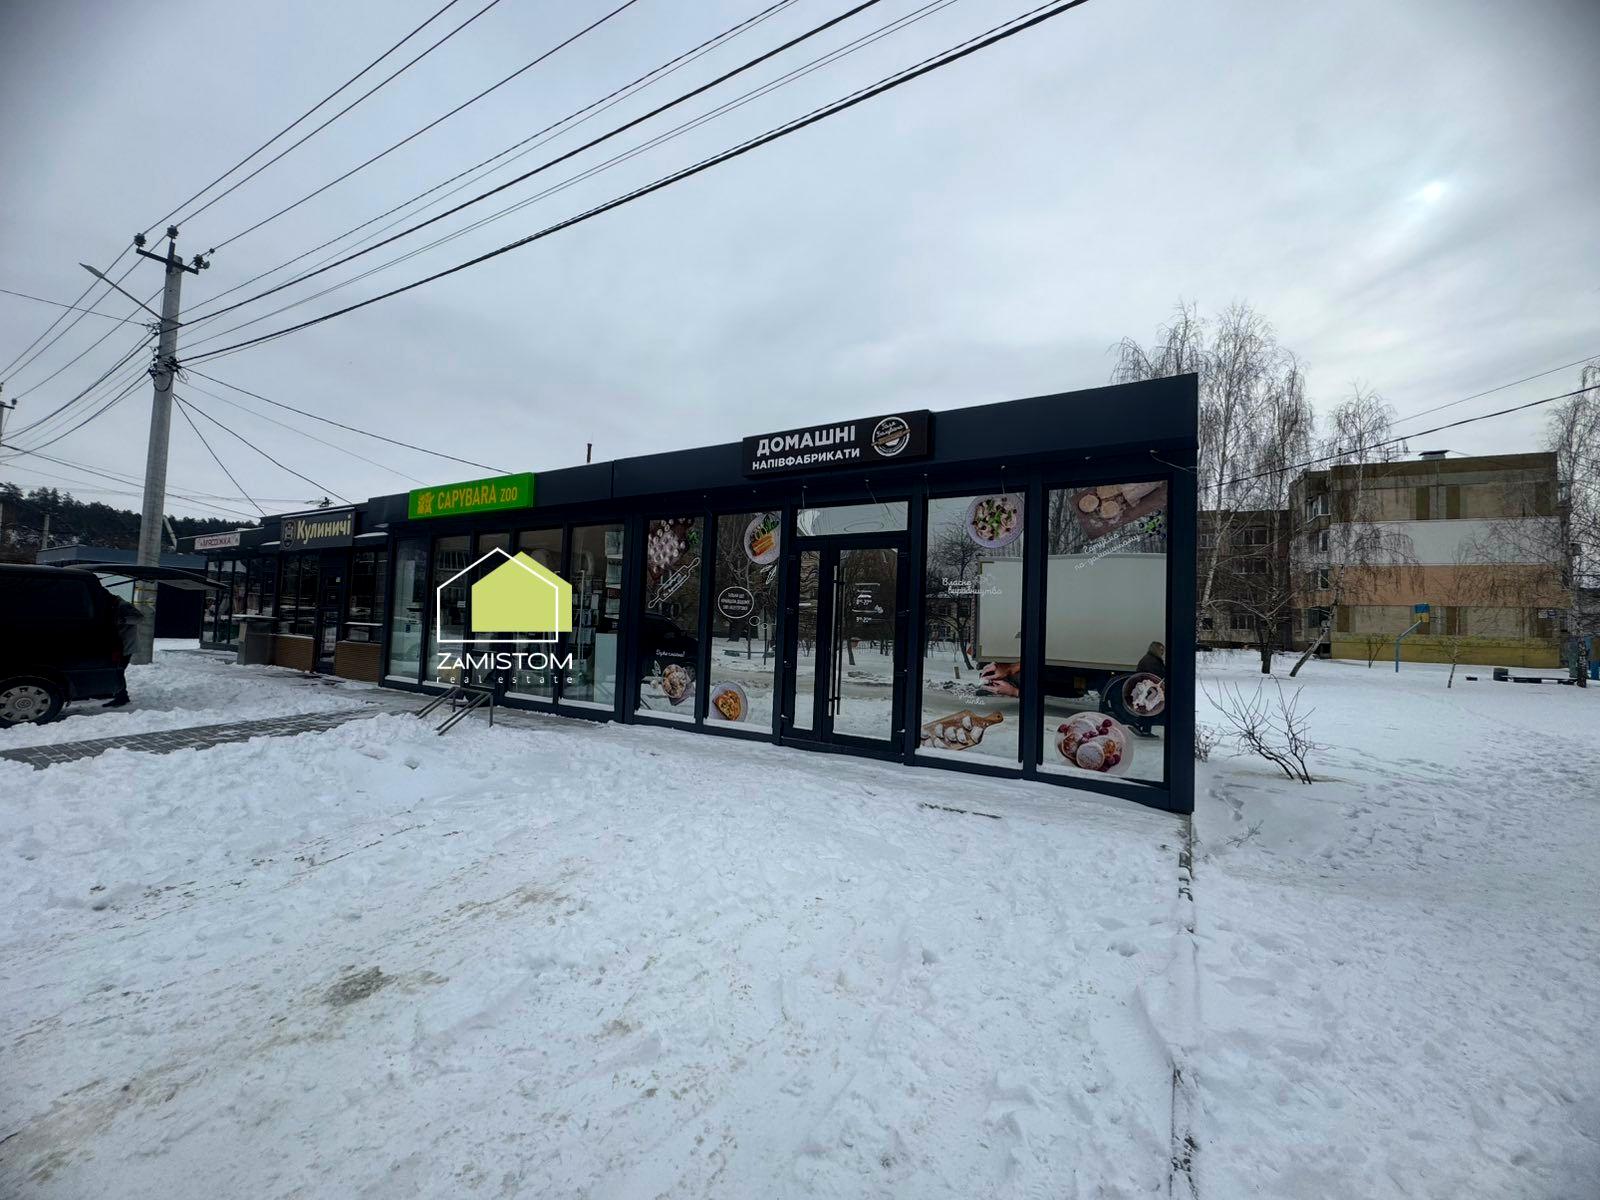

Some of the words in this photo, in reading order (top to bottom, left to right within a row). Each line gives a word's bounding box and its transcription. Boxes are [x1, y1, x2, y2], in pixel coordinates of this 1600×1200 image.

[756, 425, 856, 457] ДОМАШНІ
[752, 448, 860, 470] НАПІВФАБРИКАТИ
[437, 482, 497, 510] CAPYBARA
[296, 514, 352, 545] Кулиничі
